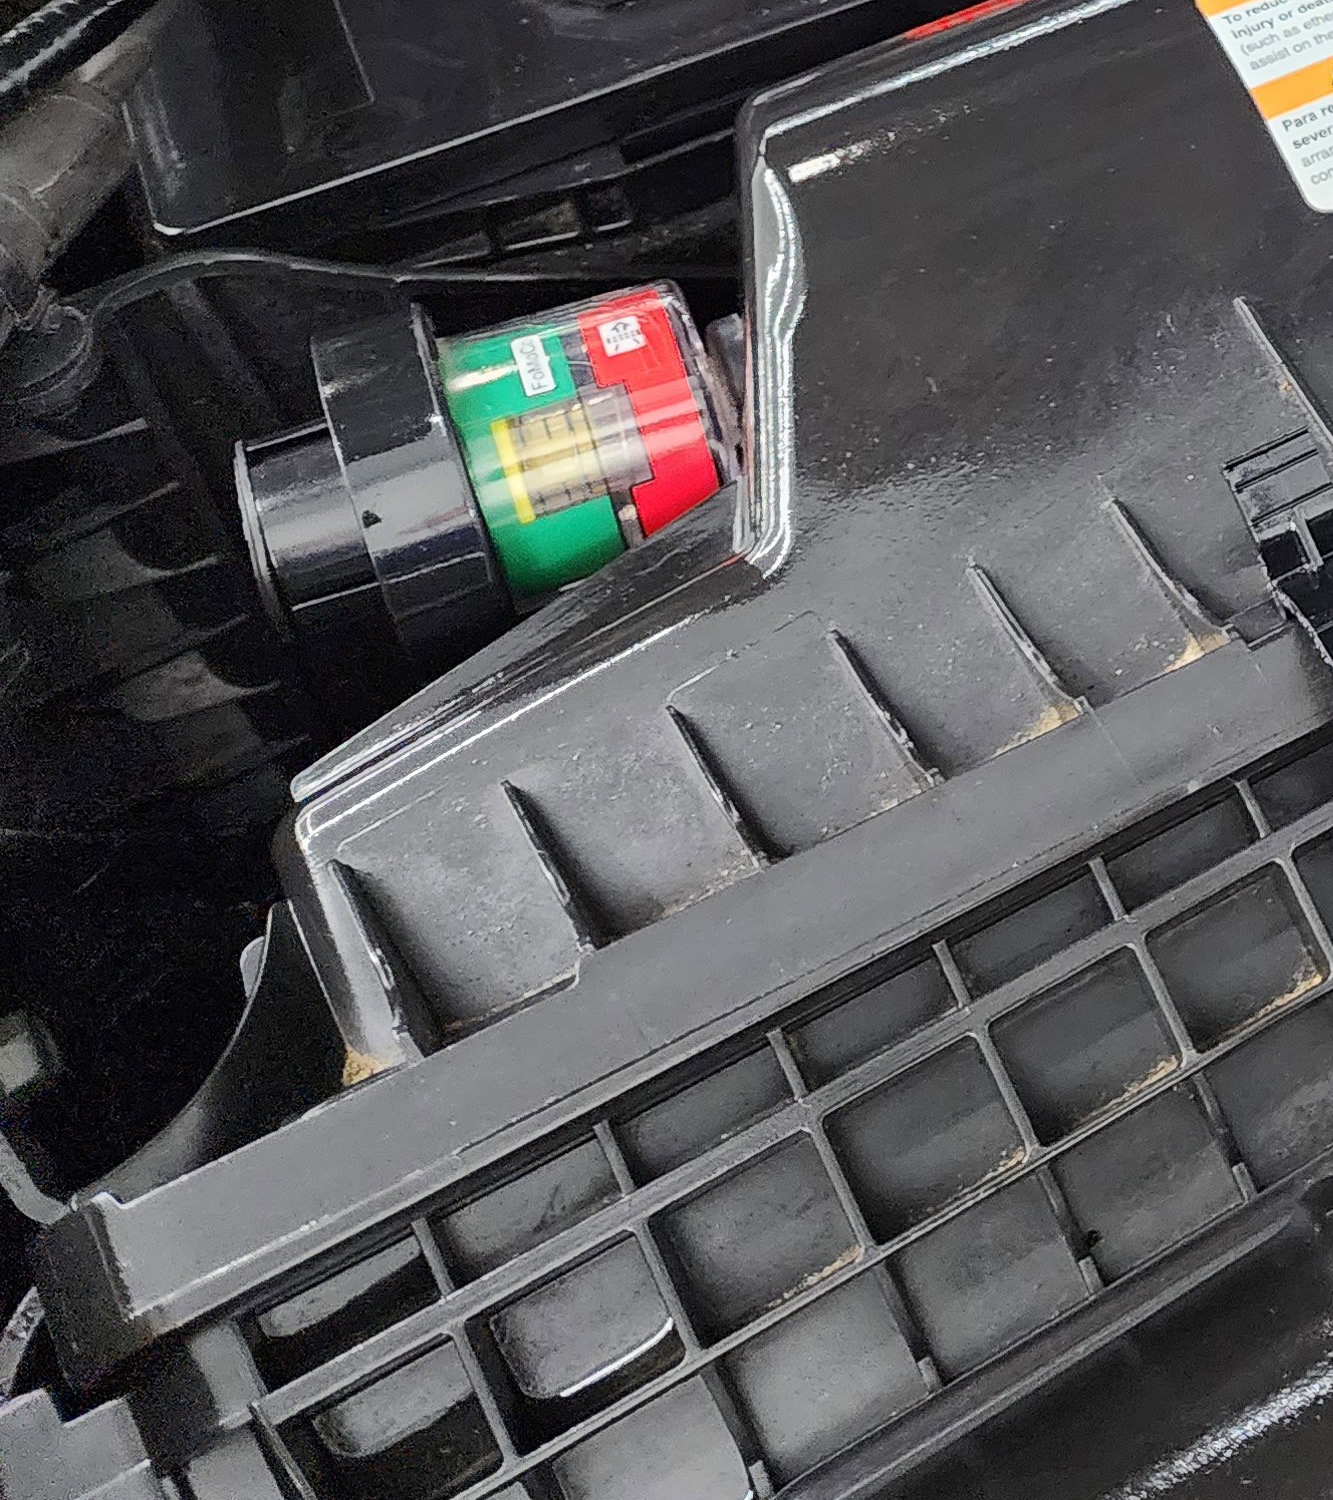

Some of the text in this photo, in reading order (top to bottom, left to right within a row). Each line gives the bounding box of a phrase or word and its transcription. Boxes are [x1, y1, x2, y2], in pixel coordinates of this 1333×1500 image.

[1238, 32, 1282, 57] (such
[1247, 45, 1292, 71] assist
[1280, 110, 1319, 133] Para
[519, 337, 548, 391] FoMoCo
